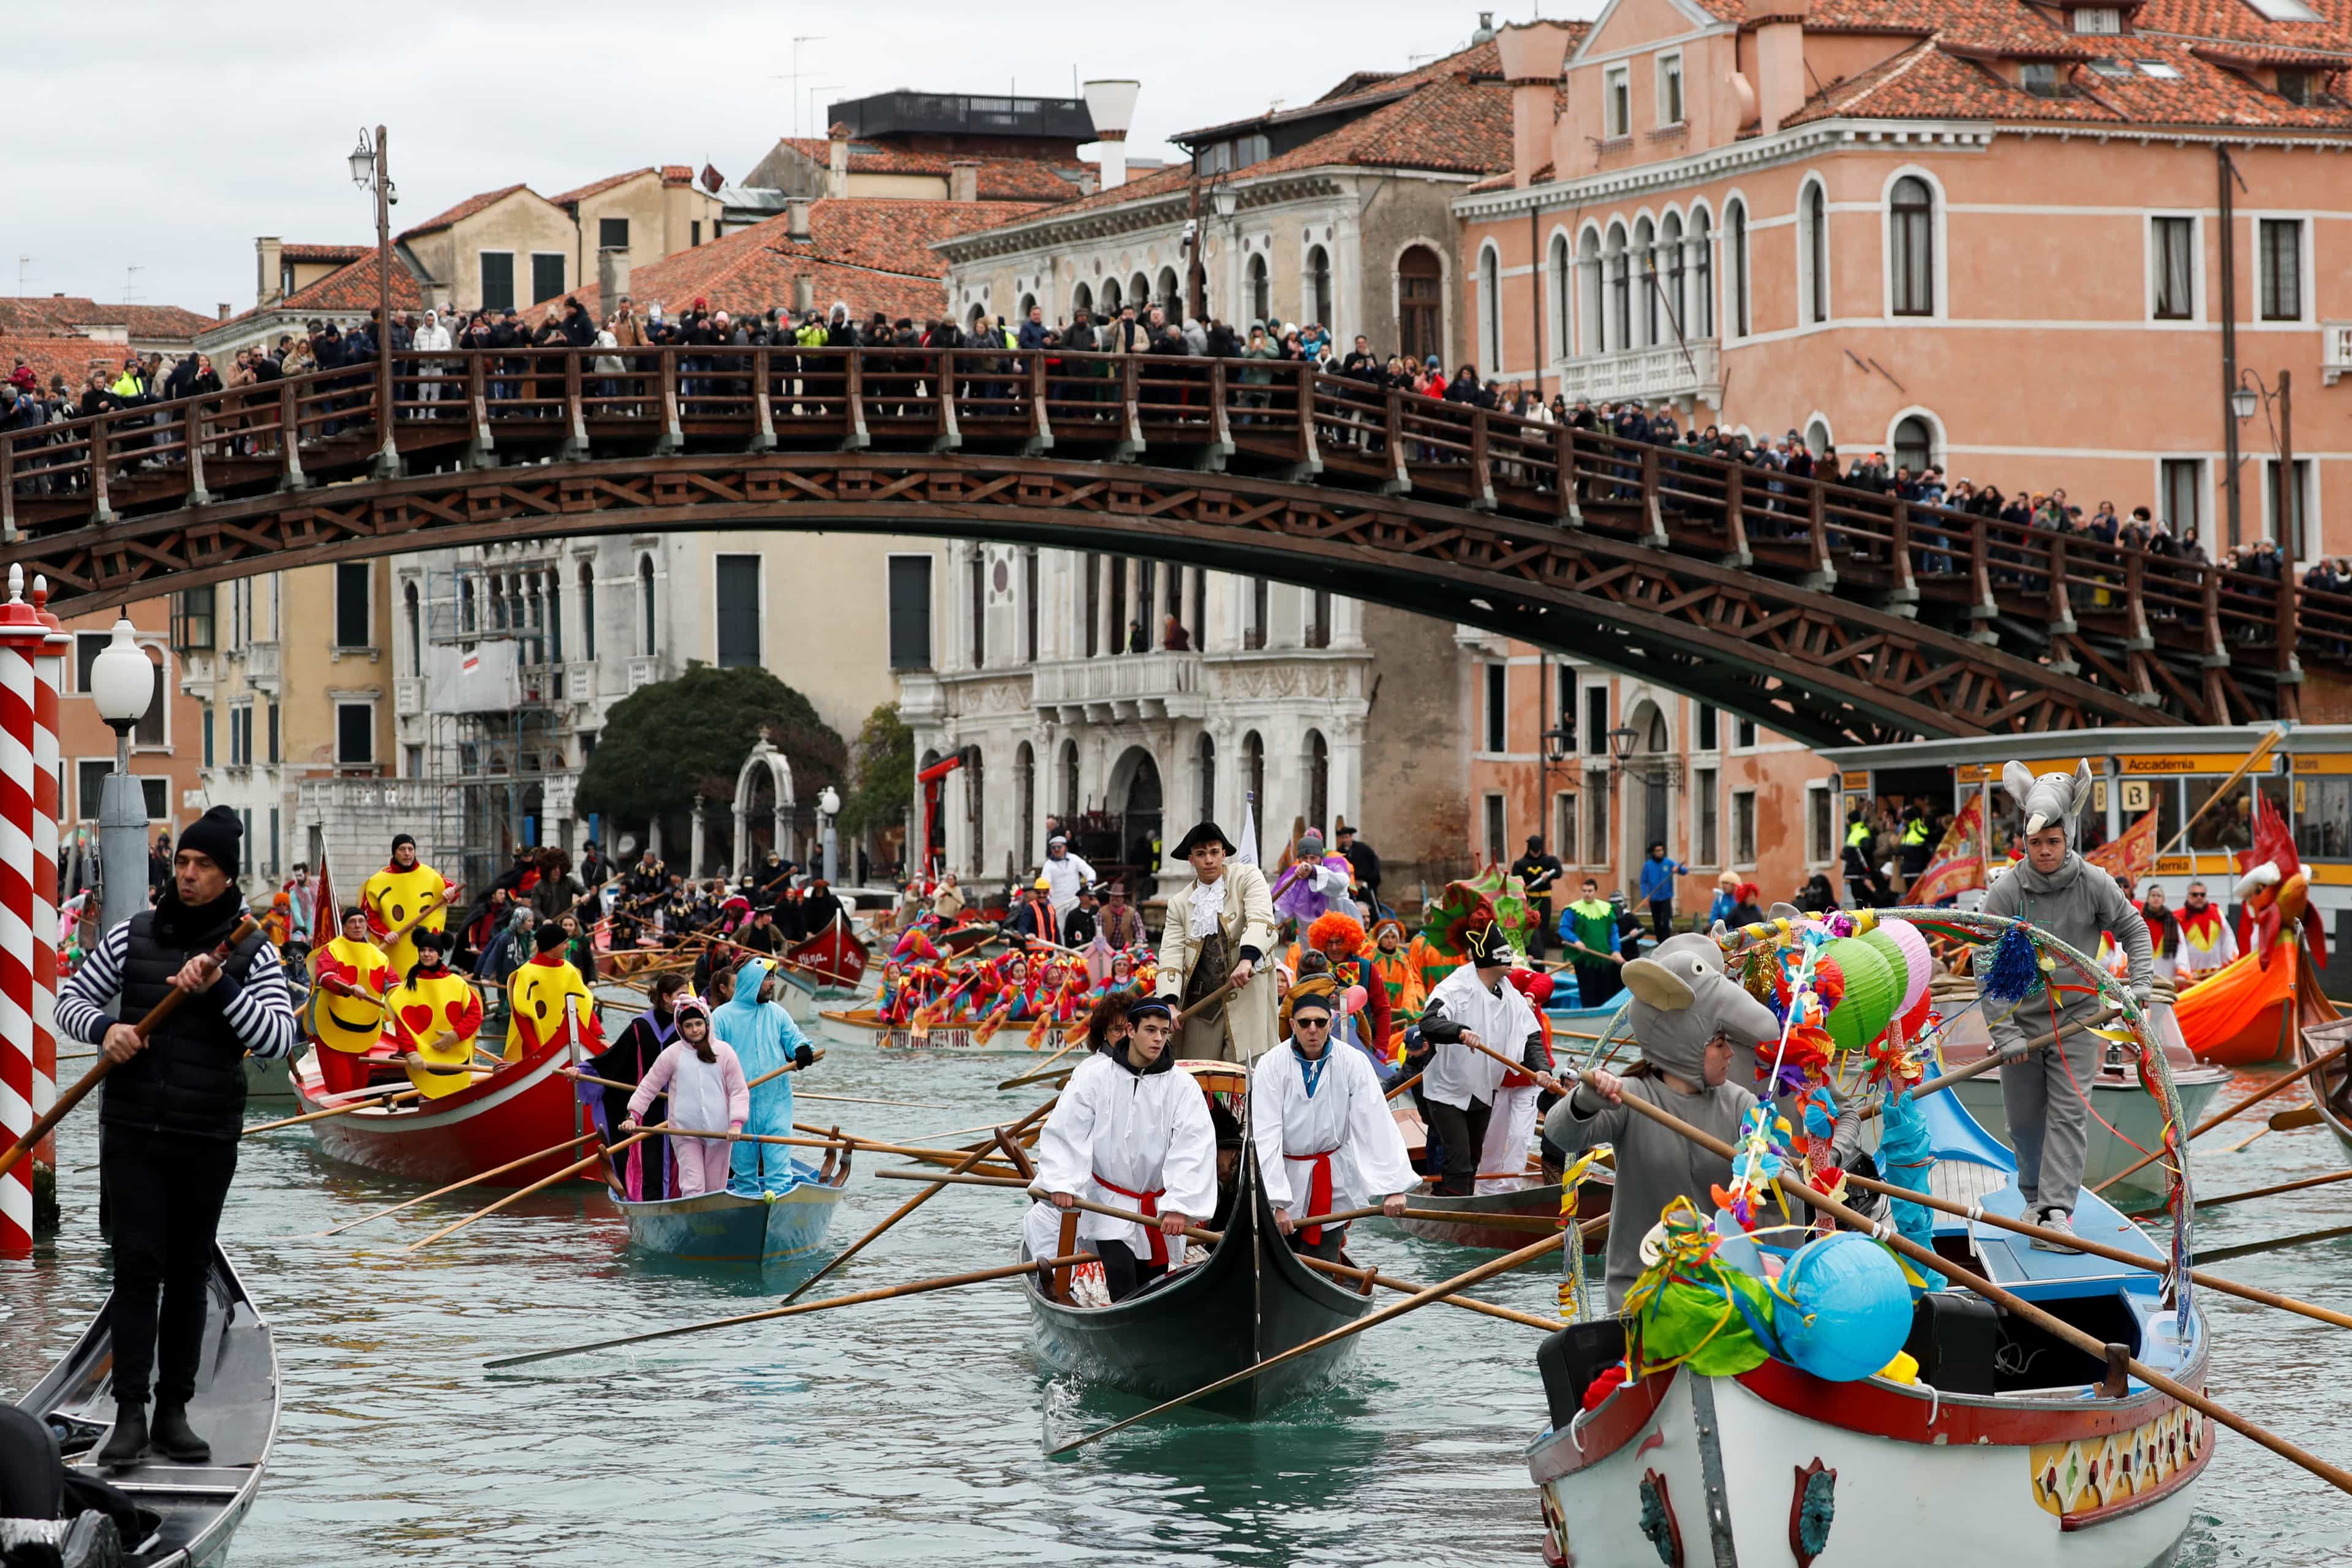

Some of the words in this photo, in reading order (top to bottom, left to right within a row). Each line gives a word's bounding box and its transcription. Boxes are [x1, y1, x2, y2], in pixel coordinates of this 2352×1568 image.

[2128, 758, 2195, 770] Accademia
[2129, 786, 2142, 805] B
[2155, 859, 2190, 871] demia
[951, 1030, 970, 1047] 1882
